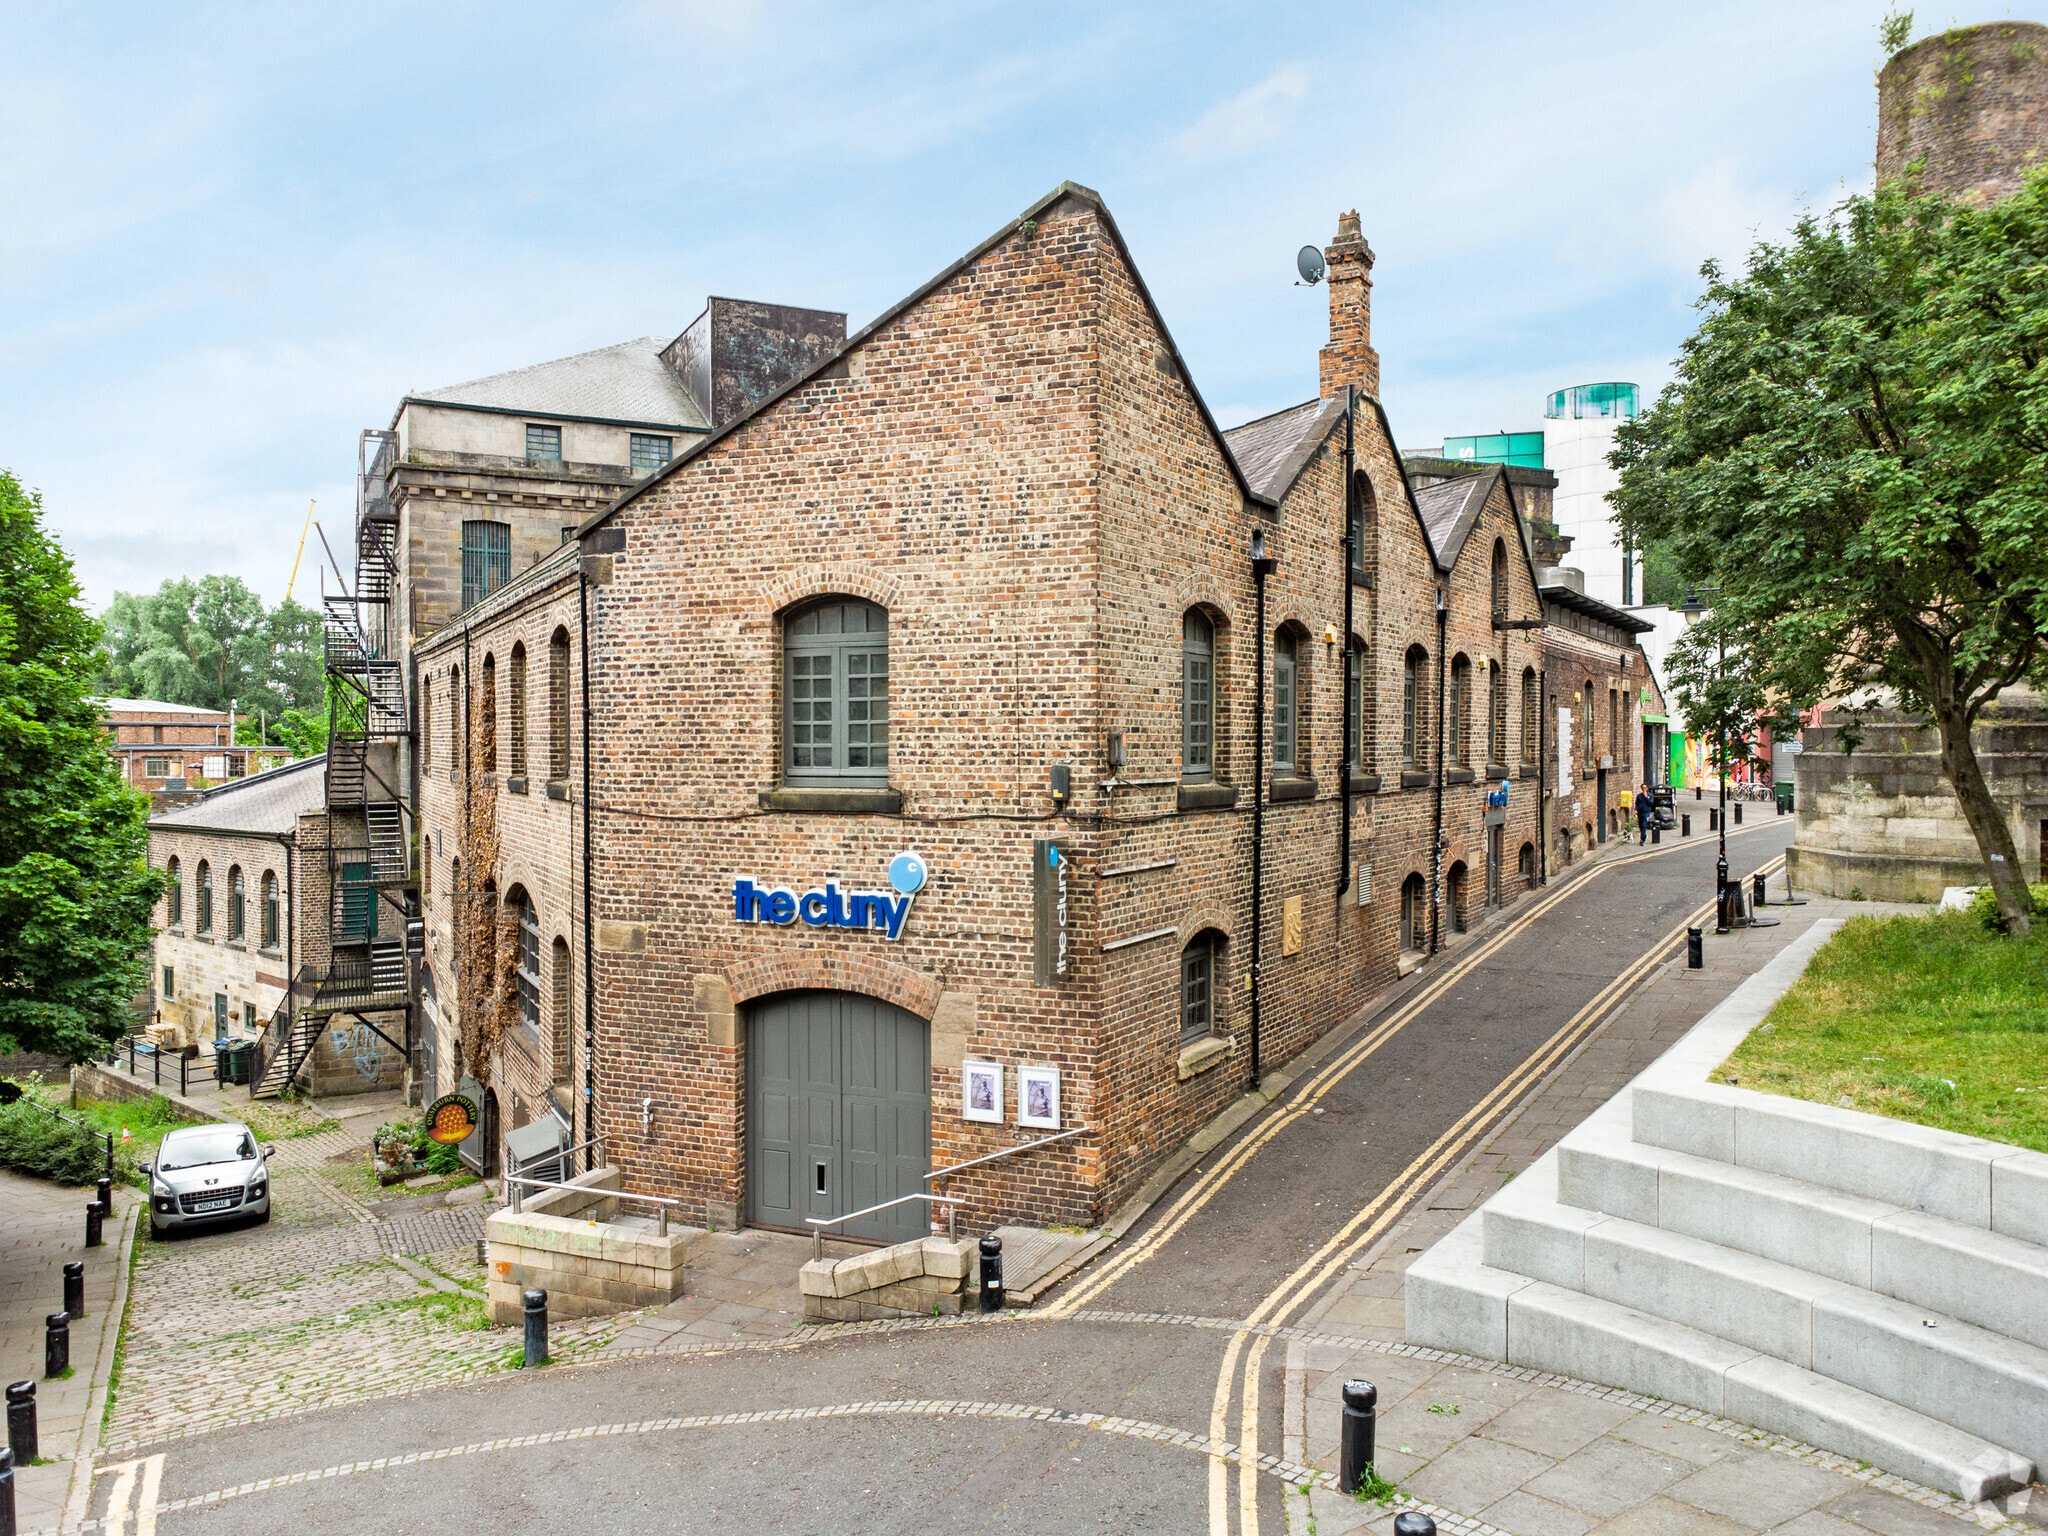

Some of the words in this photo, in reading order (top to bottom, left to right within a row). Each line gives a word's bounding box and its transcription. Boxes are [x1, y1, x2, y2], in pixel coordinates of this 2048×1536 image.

[732, 877, 798, 925] the
[800, 879, 912, 940] cluny
[1057, 854, 1068, 927] cluny
[1057, 931, 1067, 975] the
[426, 1095, 455, 1126] OUSEBURN
[456, 1095, 477, 1121] POTTERY
